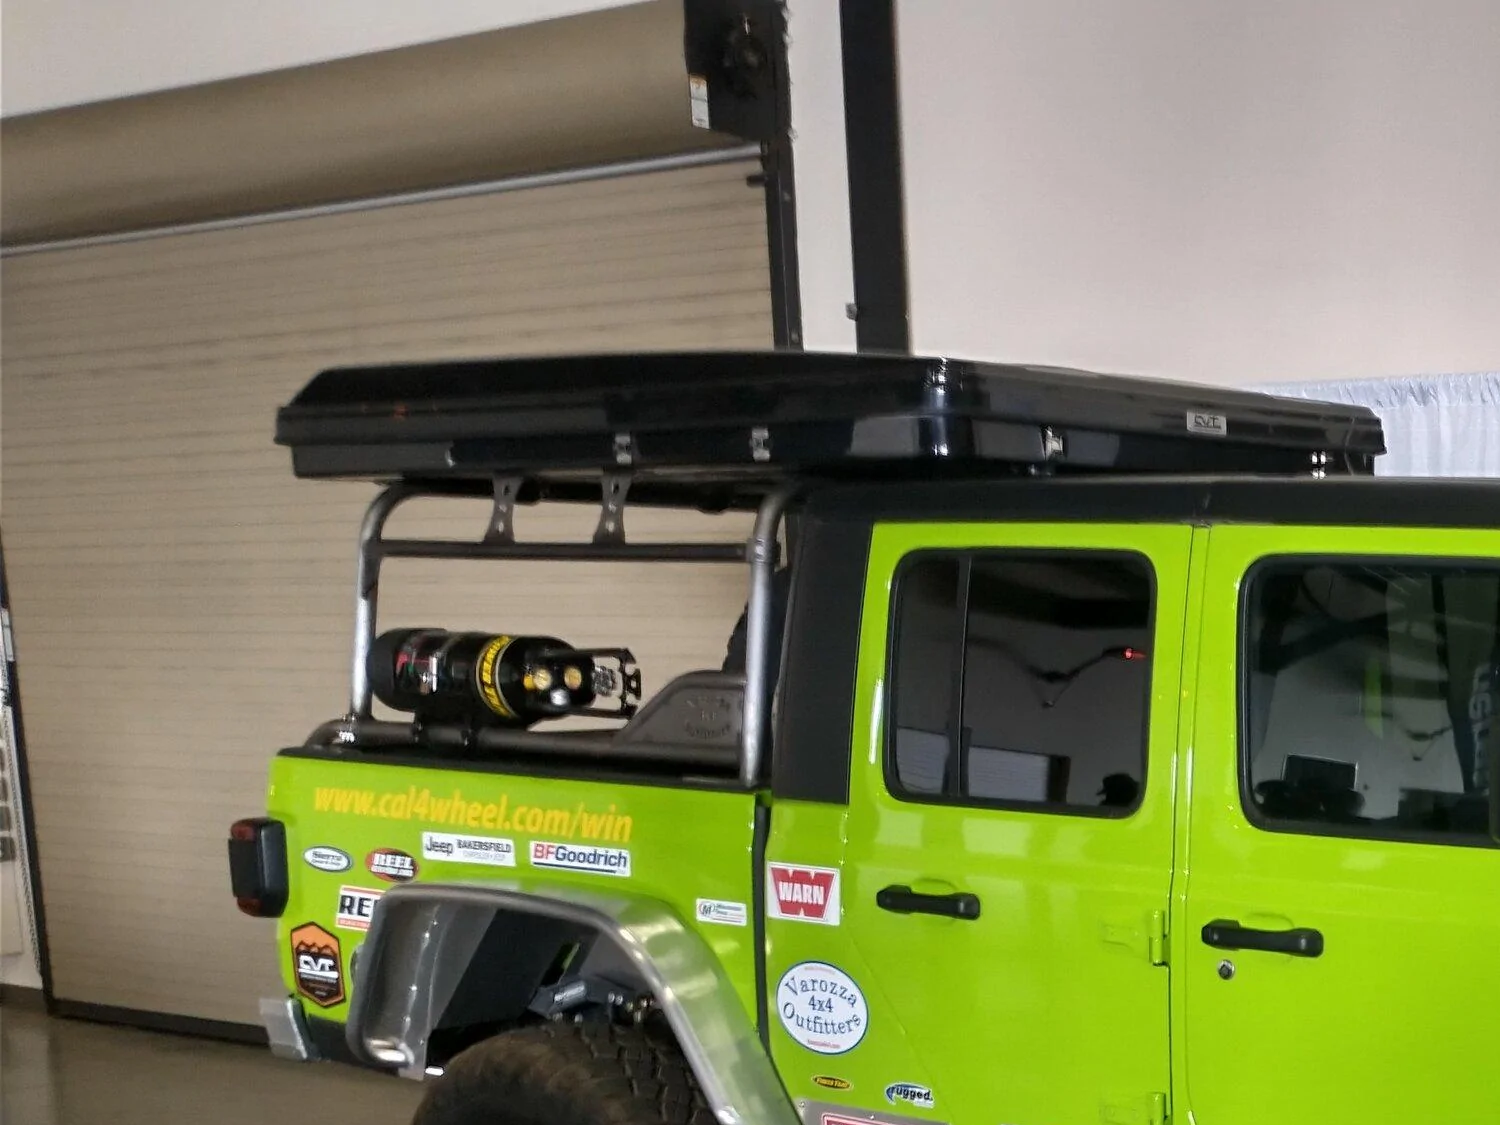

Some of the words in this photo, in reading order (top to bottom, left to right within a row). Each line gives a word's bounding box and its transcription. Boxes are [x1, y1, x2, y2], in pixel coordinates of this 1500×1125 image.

[314, 785, 633, 843] www.cal4wheel.com/win
[426, 837, 453, 856] Jeep
[456, 839, 512, 854] BAKERSFIELD
[533, 843, 628, 868] BFGoodrich
[779, 881, 825, 905] WARN
[340, 895, 376, 917] RE
[785, 976, 857, 1008] Varozza
[808, 995, 834, 1013] 4x4
[783, 1003, 861, 1035] Outfitters
